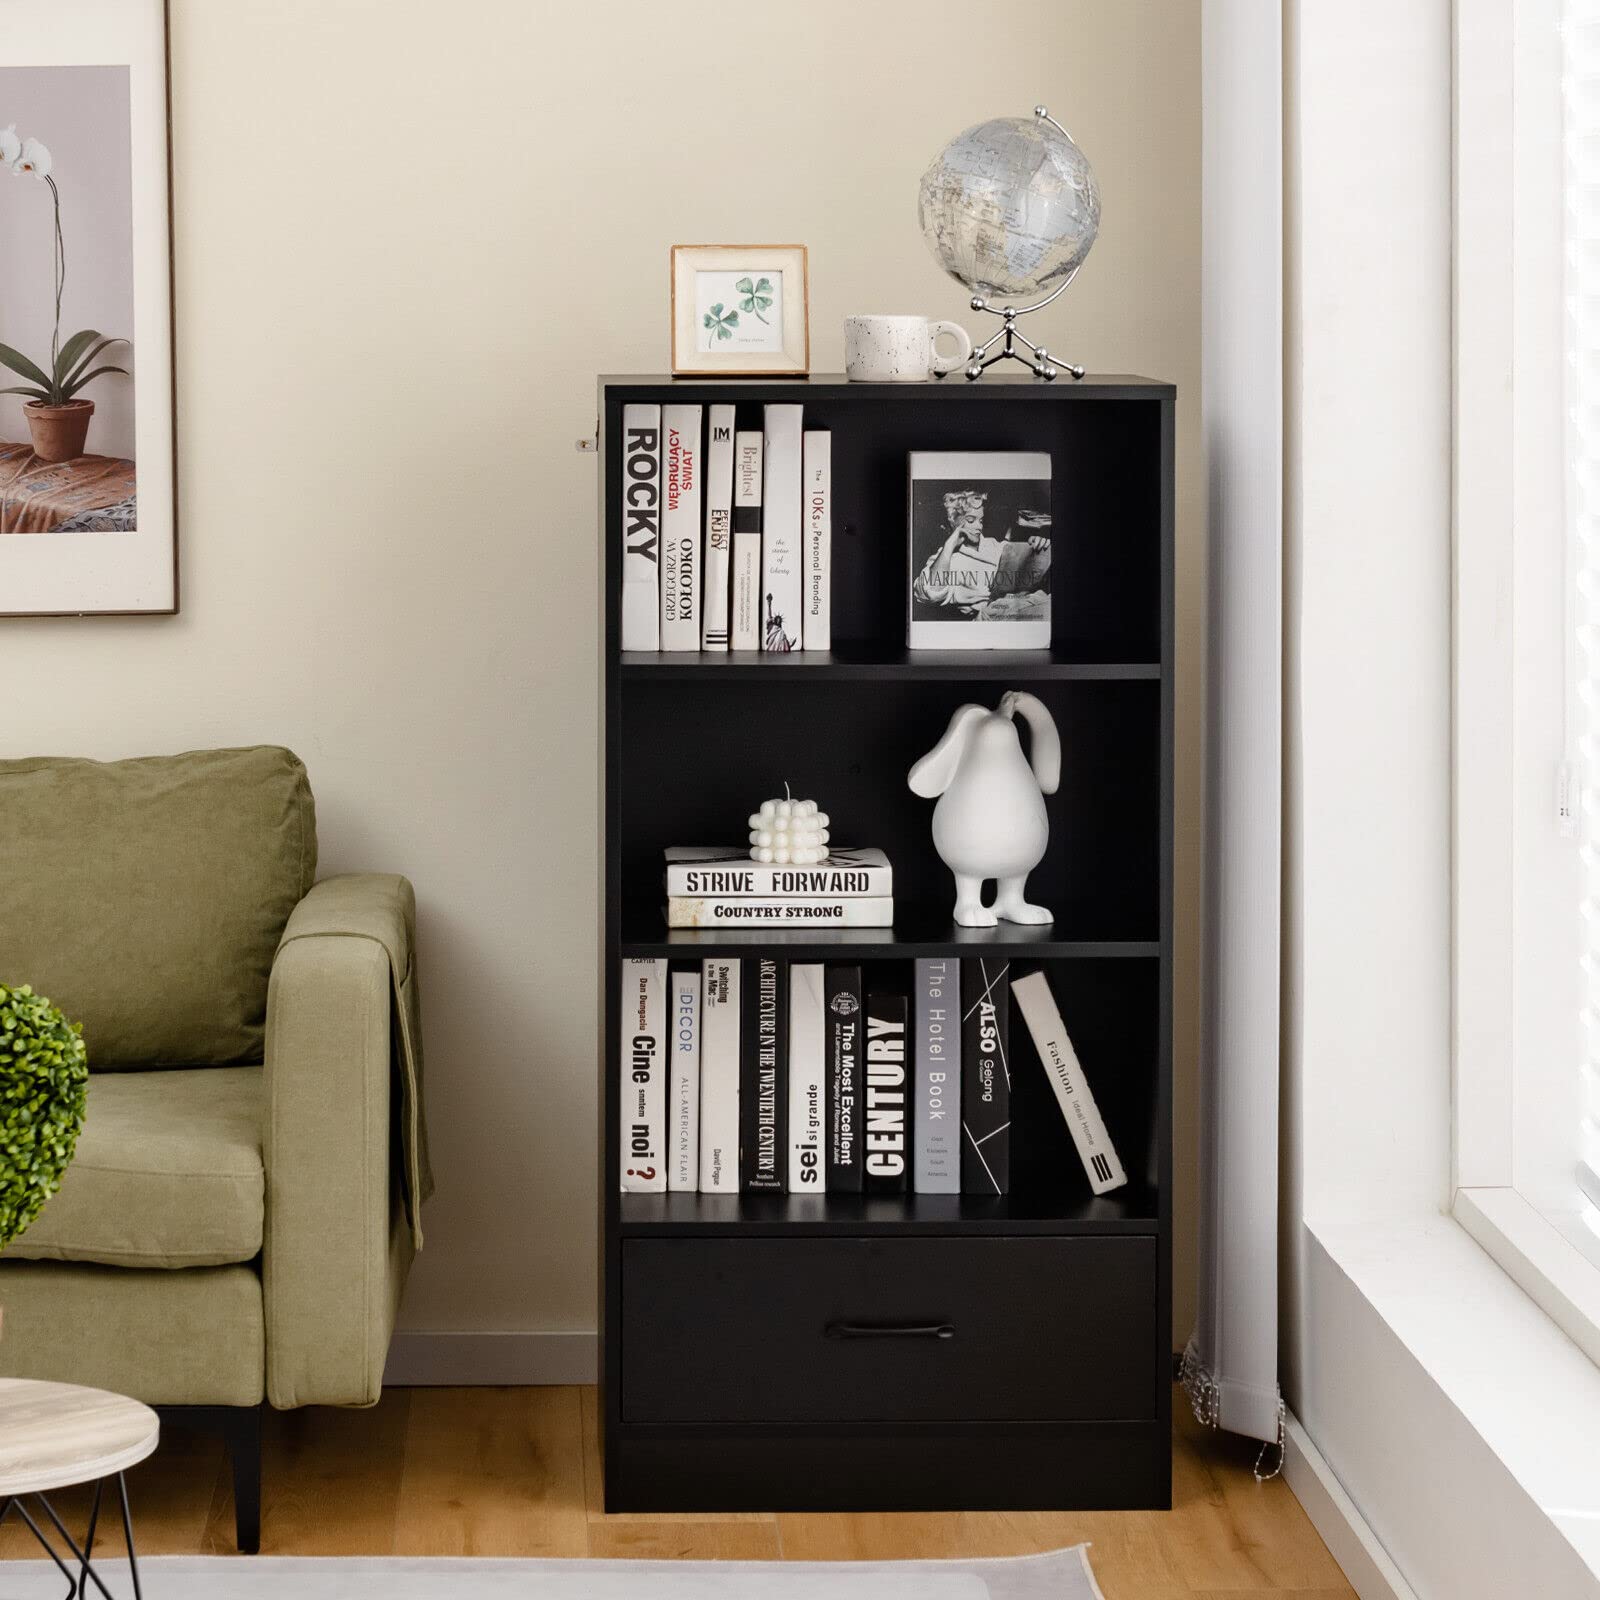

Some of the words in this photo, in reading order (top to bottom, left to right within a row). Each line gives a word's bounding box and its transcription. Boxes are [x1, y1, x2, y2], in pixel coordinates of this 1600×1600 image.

[713, 427, 730, 440] IM
[668, 429, 681, 511] WĘDRUJĄCY
[680, 449, 693, 491] ŚWIAT
[738, 447, 758, 497] Brightest
[627, 428, 658, 563] ROCKY
[812, 490, 824, 521] 10Ks
[666, 538, 677, 553] W.
[711, 509, 721, 550] ENJOY
[720, 509, 729, 551] PERFECT
[812, 531, 822, 571] Personal
[666, 555, 677, 621] GRZEGORZ
[680, 538, 693, 621] KOŁODKO
[811, 575, 822, 616] Branding
[922, 570, 979, 587] MARILYN
[687, 872, 754, 892] STRIVE
[772, 872, 869, 892] FORWARD
[714, 905, 783, 918] COUNTRY
[785, 905, 843, 918] STRONG
[639, 978, 648, 993] Dan
[708, 979, 717, 996] Mac
[717, 966, 729, 1003] Switching
[929, 962, 946, 998] The
[637, 995, 648, 1031] Dungaciu
[680, 994, 693, 1052] DECOR
[980, 1001, 996, 1053] ALSO
[760, 1035, 775, 1046] IN
[842, 1022, 855, 1051] The
[929, 1009, 946, 1061] Hotel
[632, 1035, 656, 1084] Cine
[760, 1047, 775, 1067] THE
[842, 1055, 855, 1092] Most
[759, 1067, 775, 1125] TWENTIETH
[833, 1074, 841, 1100] Tragedy
[866, 1016, 905, 1176] CENTURY
[929, 1072, 946, 1120] Book
[981, 1059, 994, 1102] Gelang
[1046, 1041, 1074, 1095] Fashion
[1071, 1100, 1086, 1121] Ideal
[1081, 1122, 1095, 1146] Home
[680, 1077, 689, 1151] ALL-AMERICAN
[806, 1084, 820, 1127] grande
[834, 1101, 840, 1109] of
[631, 1124, 655, 1158] noi
[759, 1126, 775, 1172] CENTURY
[806, 1130, 817, 1141] si
[841, 1096, 854, 1165] Excellent
[626, 1166, 656, 1180] ?
[680, 1154, 688, 1182] FLAIR
[711, 1166, 721, 1186] Pogue
[713, 1148, 722, 1165] David
[795, 1144, 818, 1183] sei
